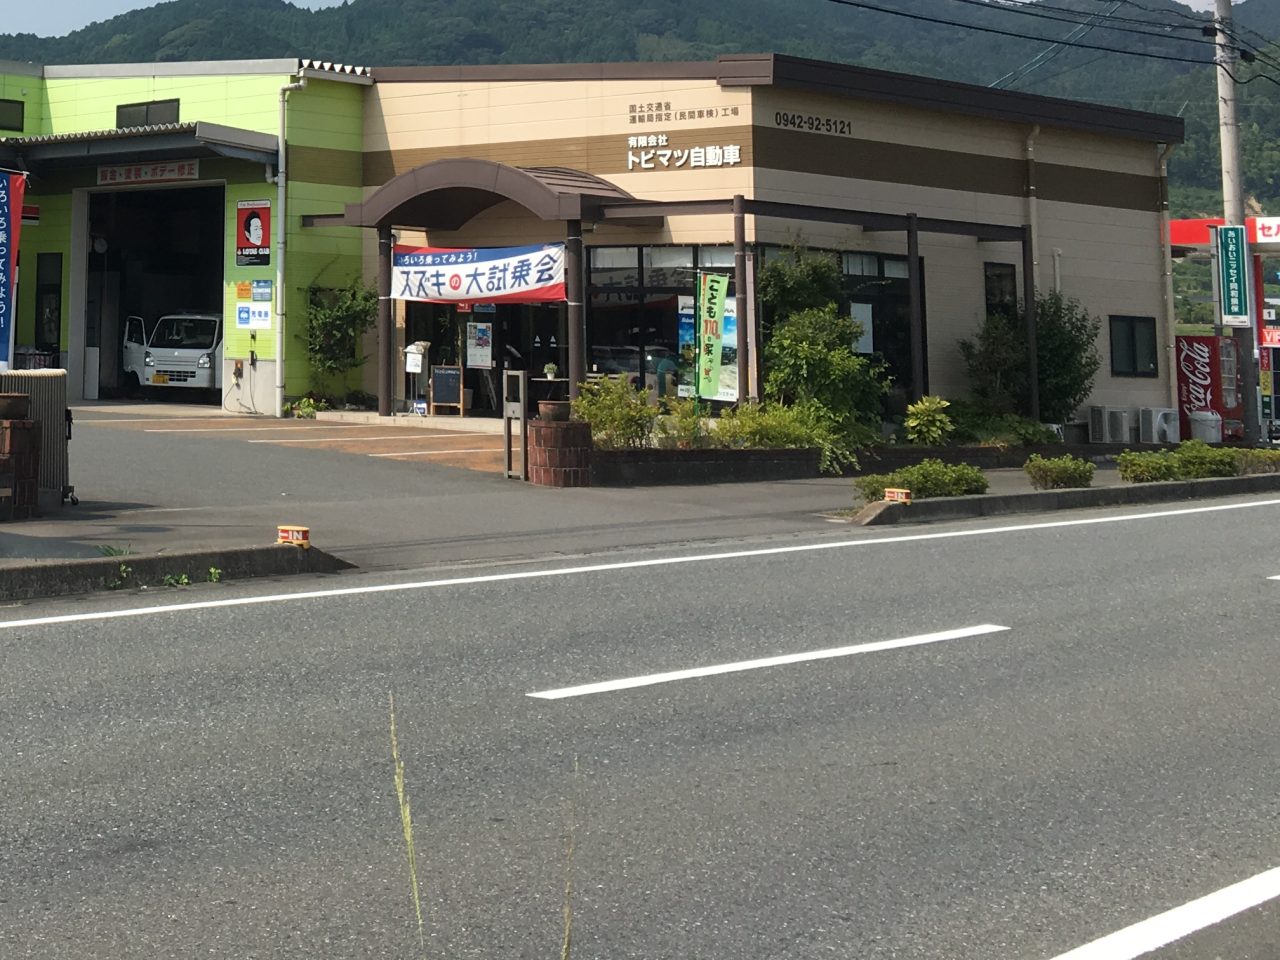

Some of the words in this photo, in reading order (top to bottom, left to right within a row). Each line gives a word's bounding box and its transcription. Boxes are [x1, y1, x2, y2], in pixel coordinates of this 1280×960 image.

[629, 102, 671, 114] 国土交通省
[775, 112, 851, 135] 0942-92-5121
[628, 134, 668, 148] 有限会社
[628, 145, 740, 170] トビマツ自動車
[400, 254, 557, 297] スズキの大試乗会
[288, 530, 302, 540] IN
